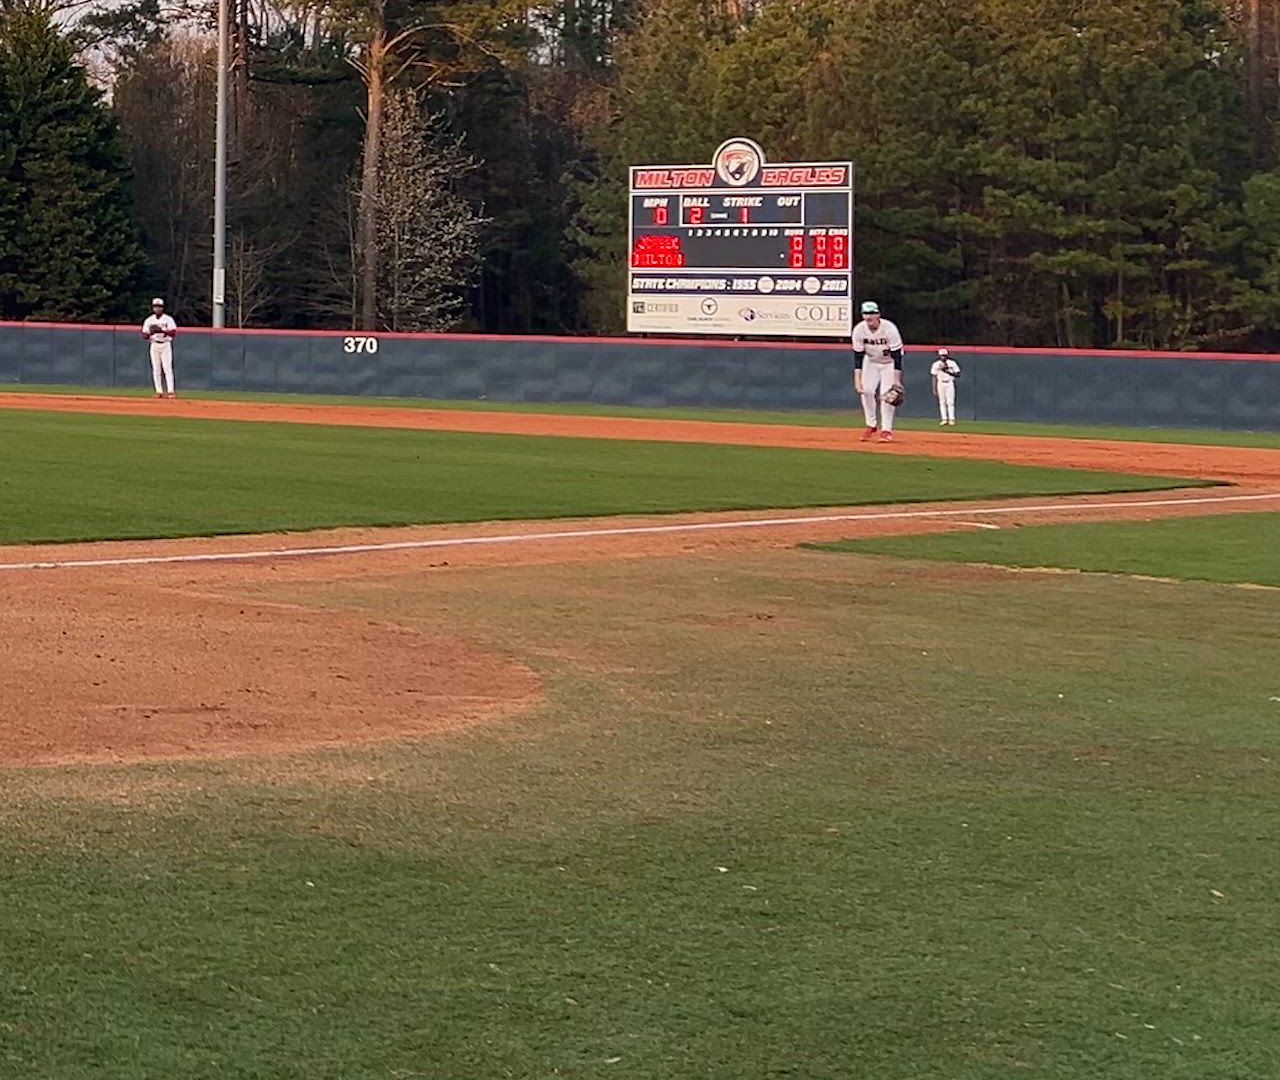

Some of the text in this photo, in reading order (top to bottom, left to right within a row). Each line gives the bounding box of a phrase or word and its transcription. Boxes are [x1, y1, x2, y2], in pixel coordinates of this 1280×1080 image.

[635, 168, 845, 188] MILTON EAGLES
[643, 198, 668, 208] MPH
[683, 196, 801, 207] BALL STRIKE OUT
[656, 207, 667, 224] 0
[690, 208, 701, 224] 2
[632, 278, 665, 289] STATE
[775, 279, 802, 291] 2004
[822, 280, 848, 291] 2013
[795, 305, 848, 321] COLE
[344, 336, 378, 353] 370
